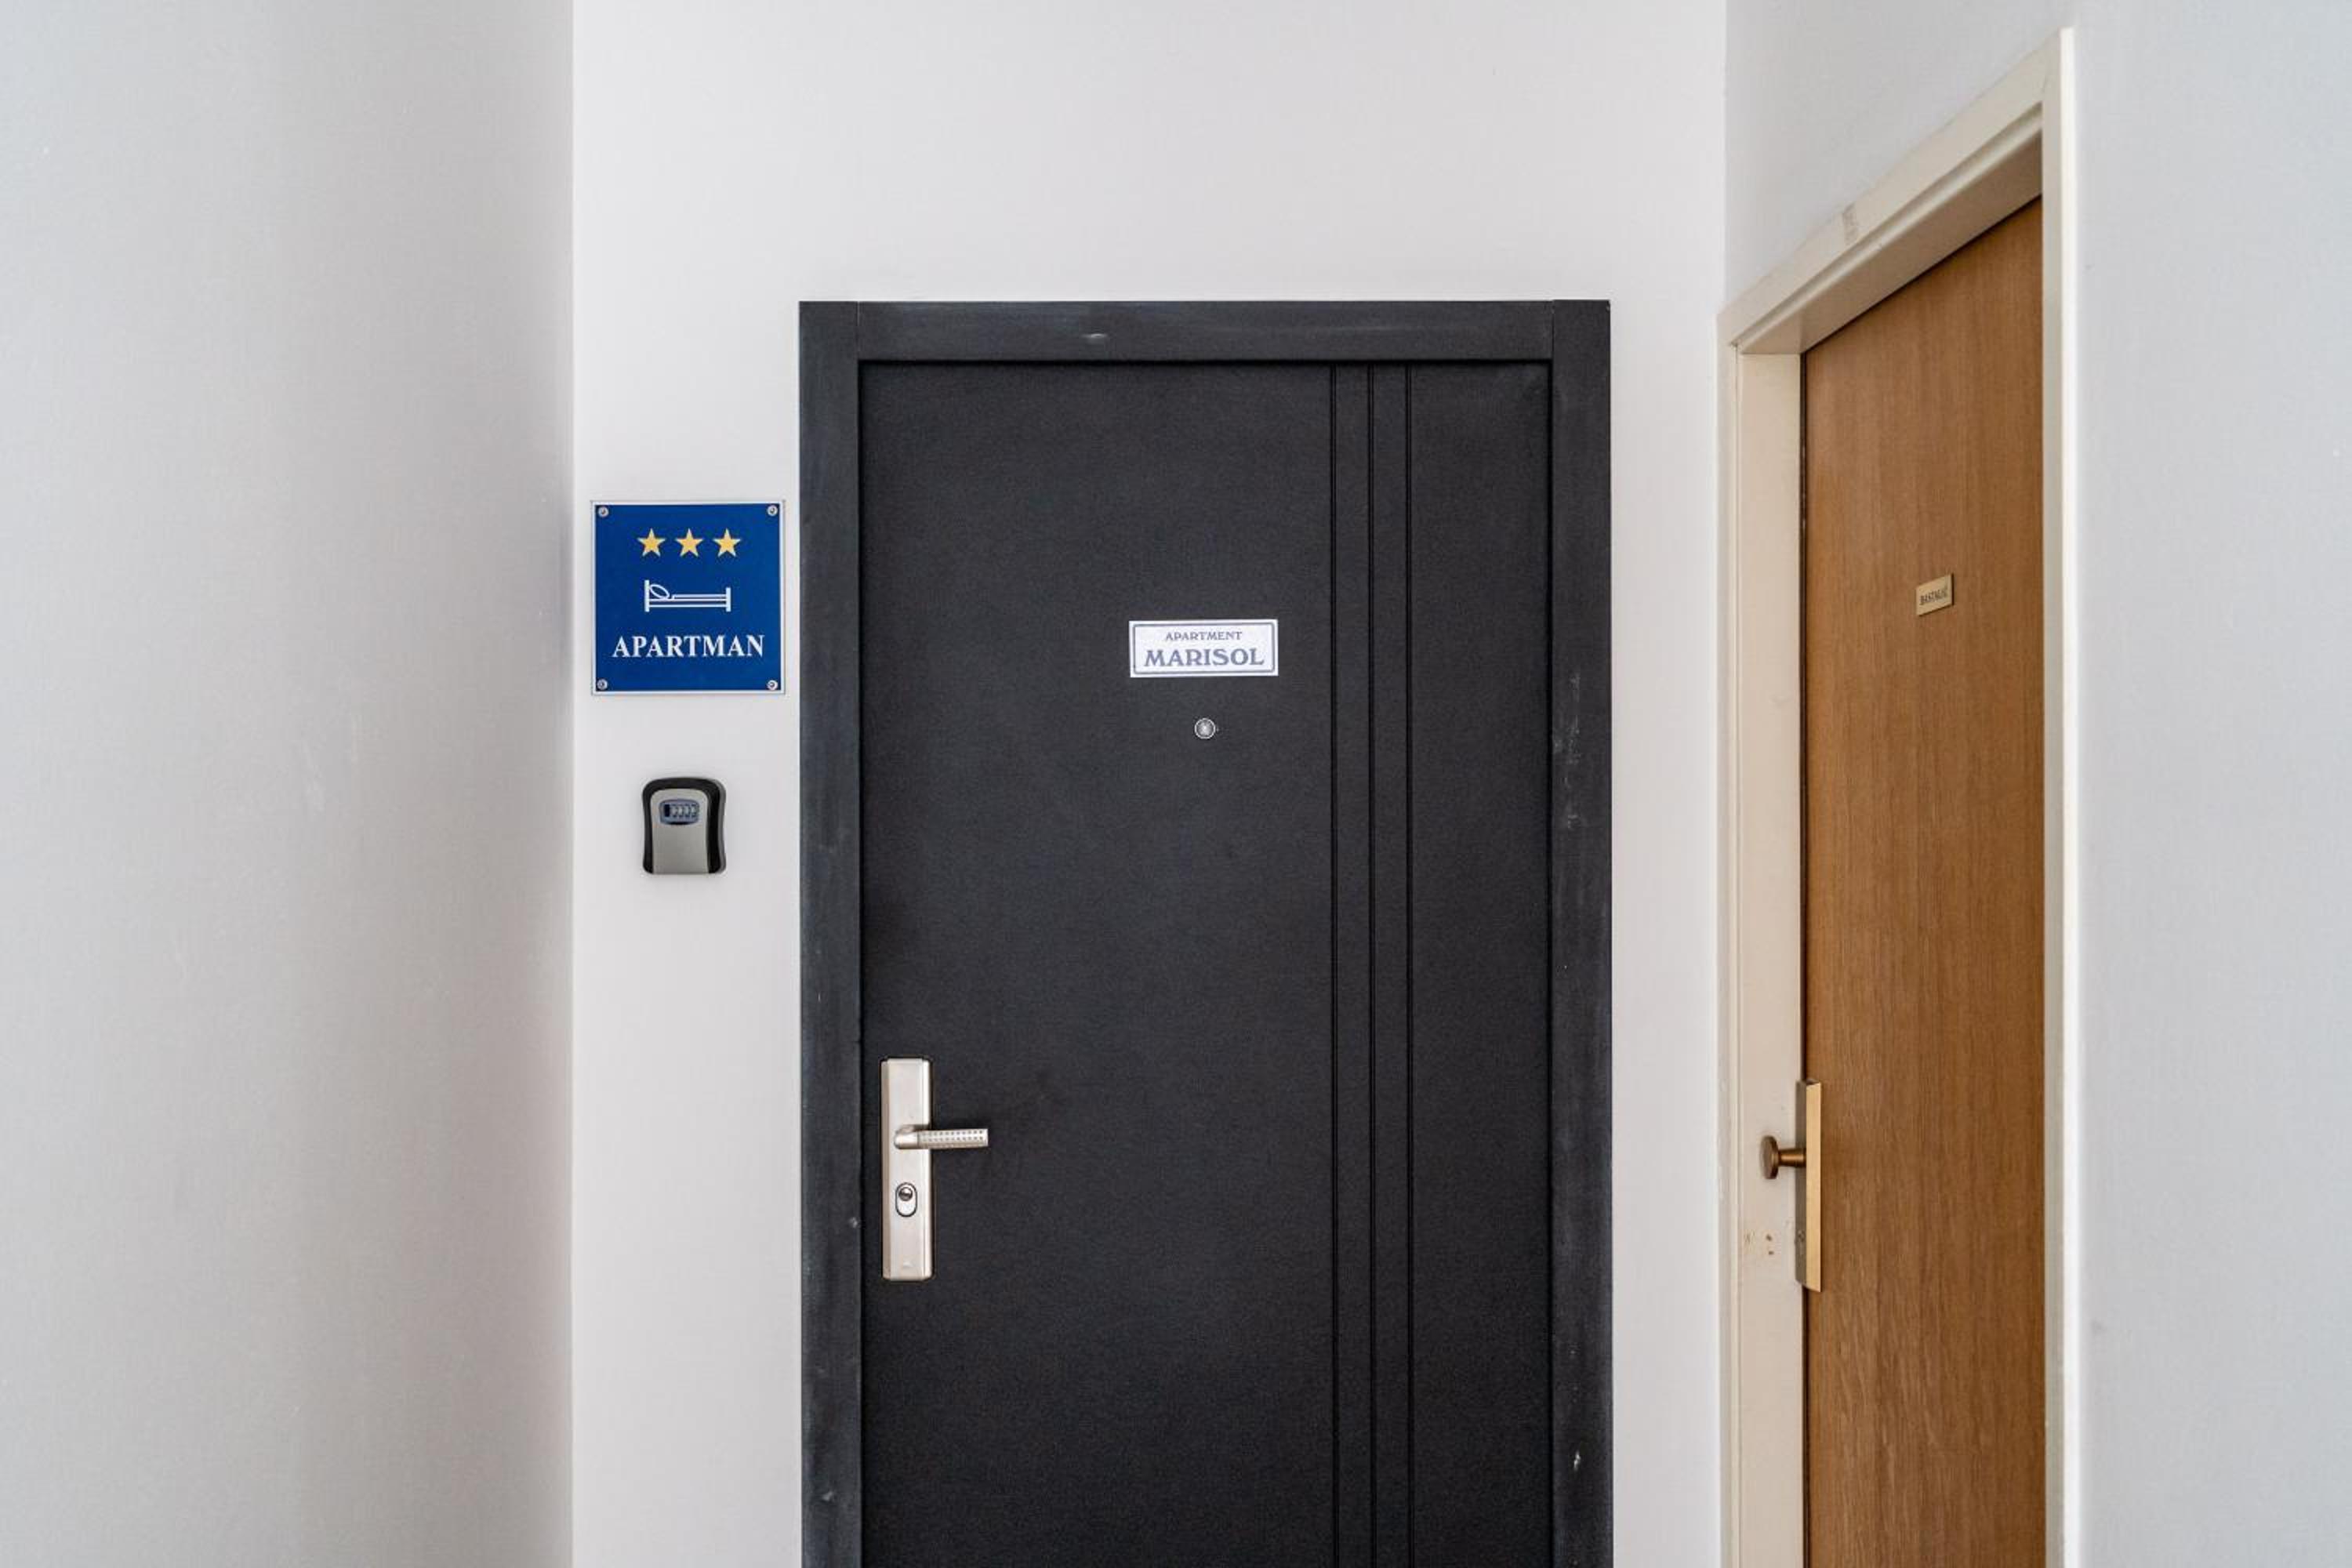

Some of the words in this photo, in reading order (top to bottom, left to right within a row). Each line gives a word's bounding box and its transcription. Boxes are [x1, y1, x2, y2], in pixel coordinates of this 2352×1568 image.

[1165, 631, 1243, 641] APARTMENT
[612, 634, 764, 658] APARTMAN
[1144, 648, 1265, 667] MARISOL
